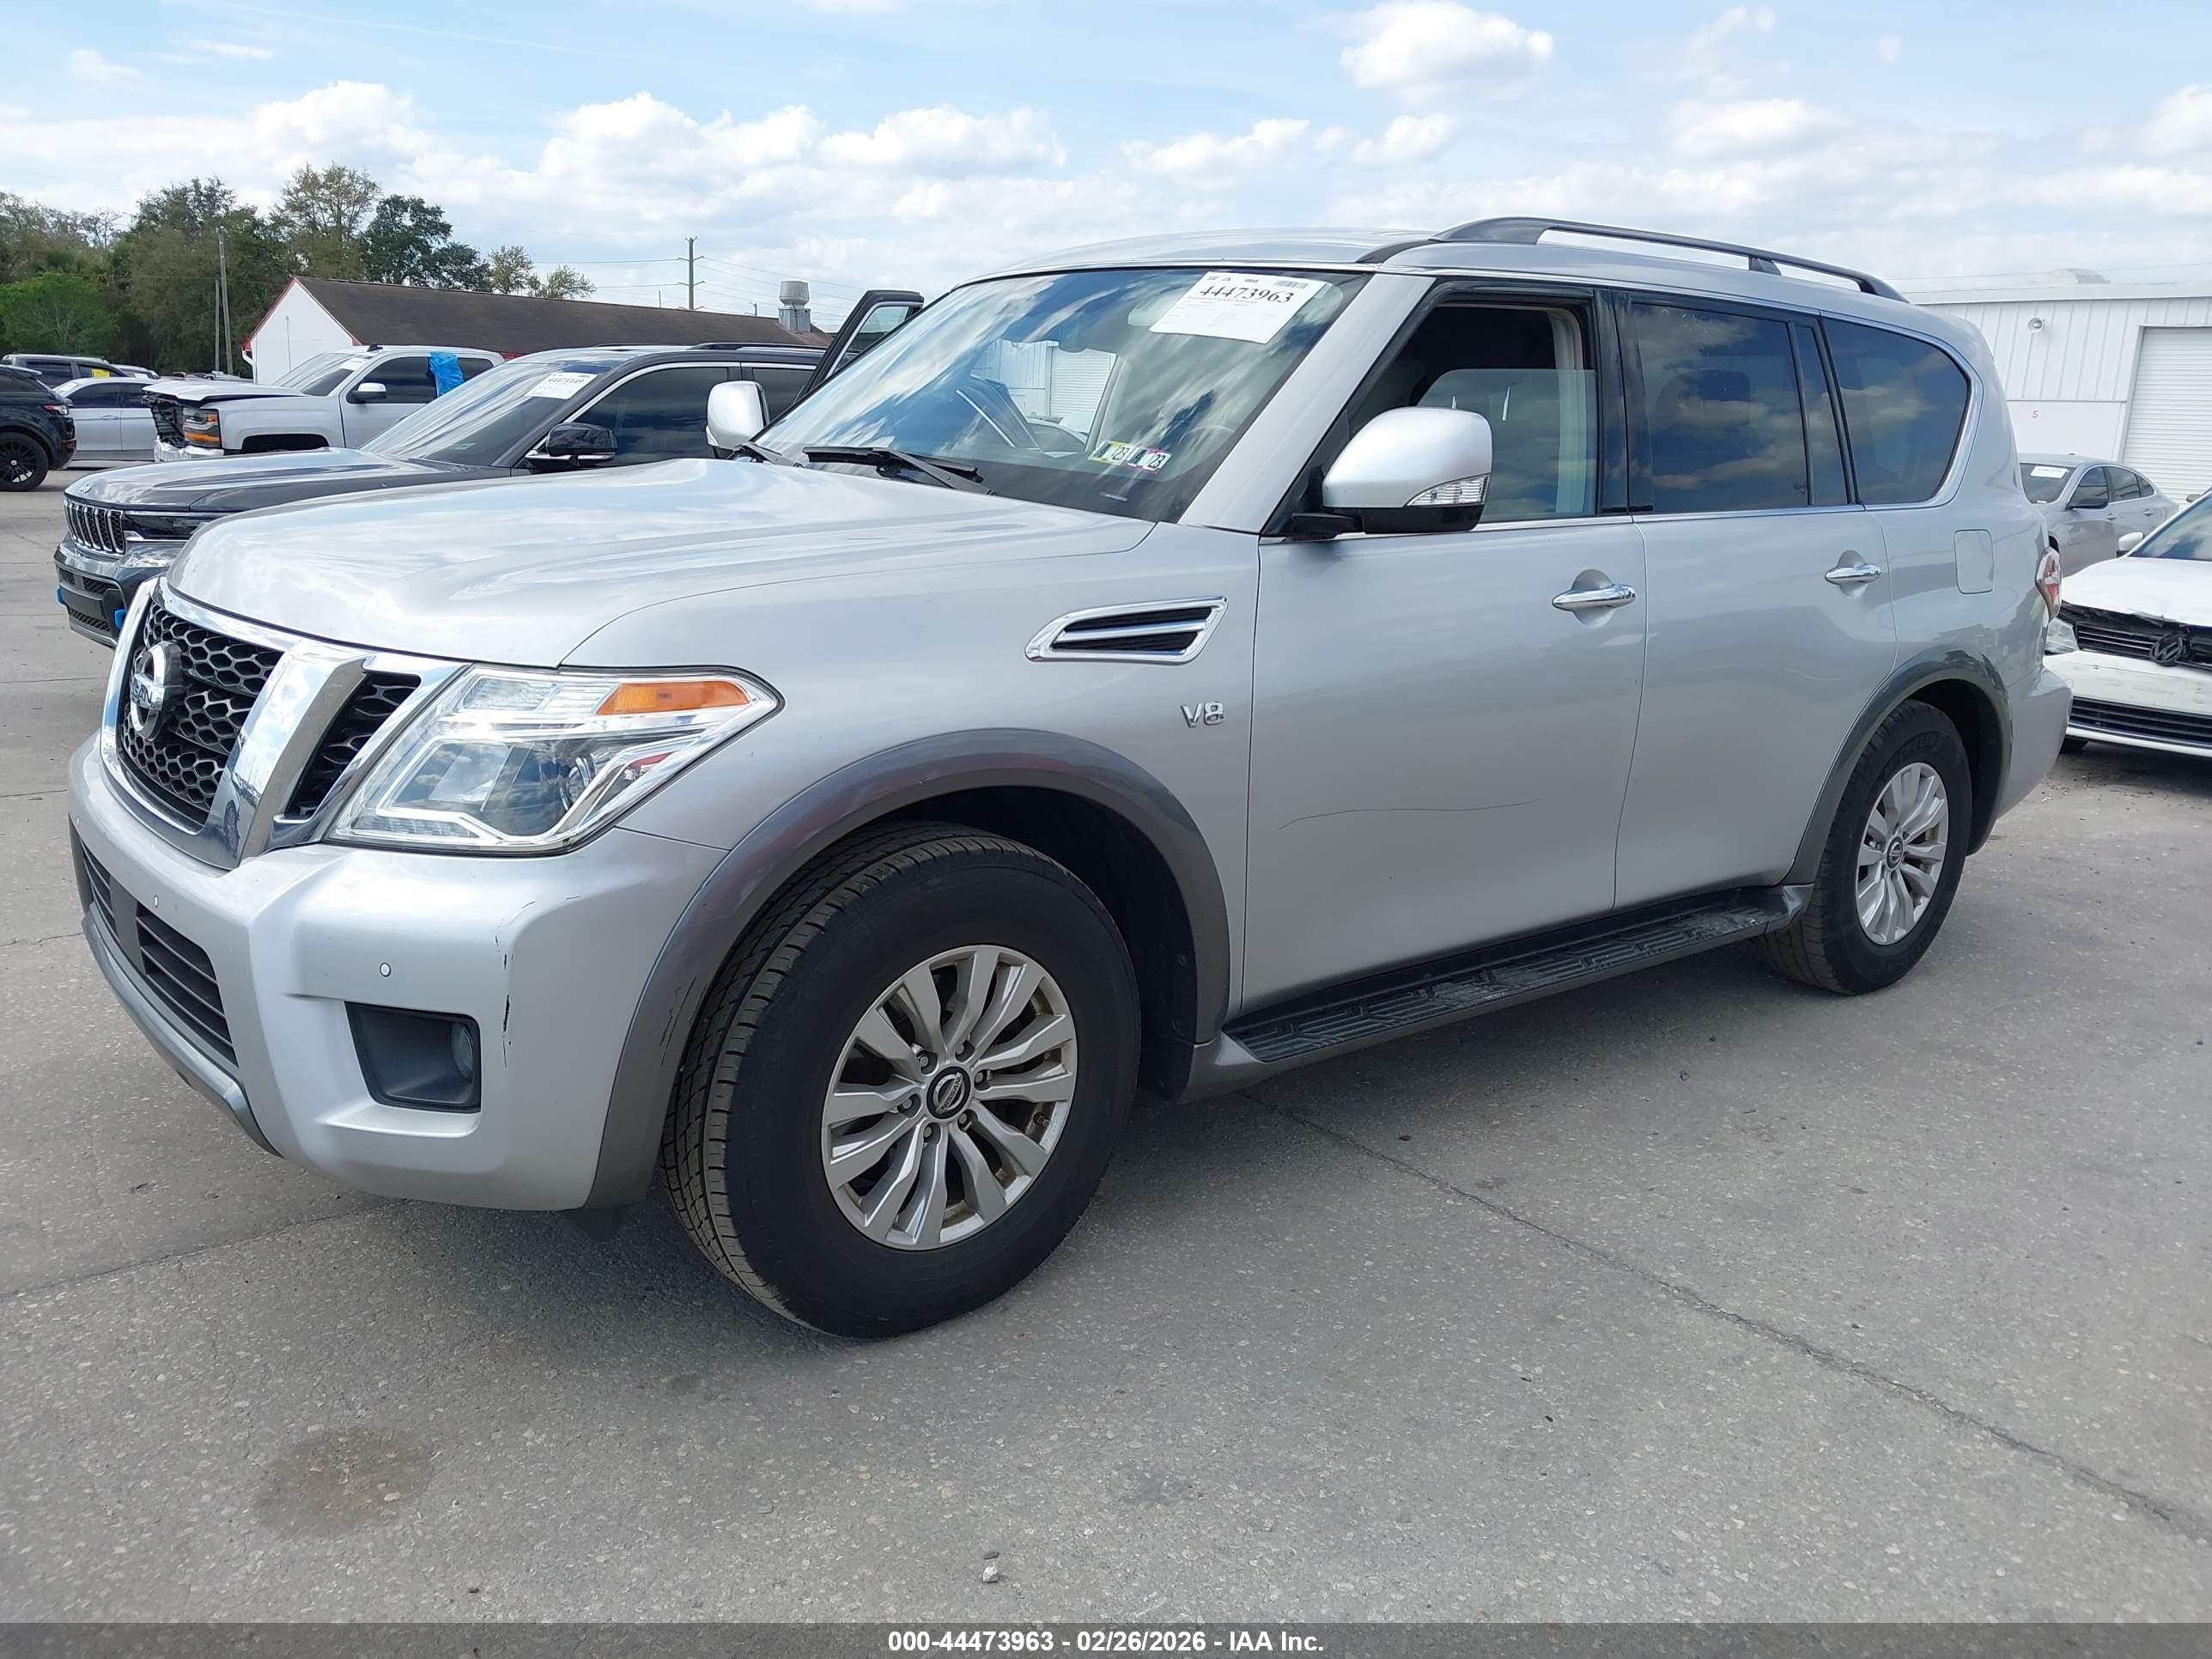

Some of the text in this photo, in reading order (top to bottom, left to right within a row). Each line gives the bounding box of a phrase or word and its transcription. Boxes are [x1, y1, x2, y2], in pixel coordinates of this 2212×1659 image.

[1199, 284, 1295, 304] 44473963
[2033, 410, 2039, 419] 5
[1147, 453, 1166, 469] 23
[1180, 701, 1224, 728] V8
[941, 1075, 962, 1109] NISSAN
